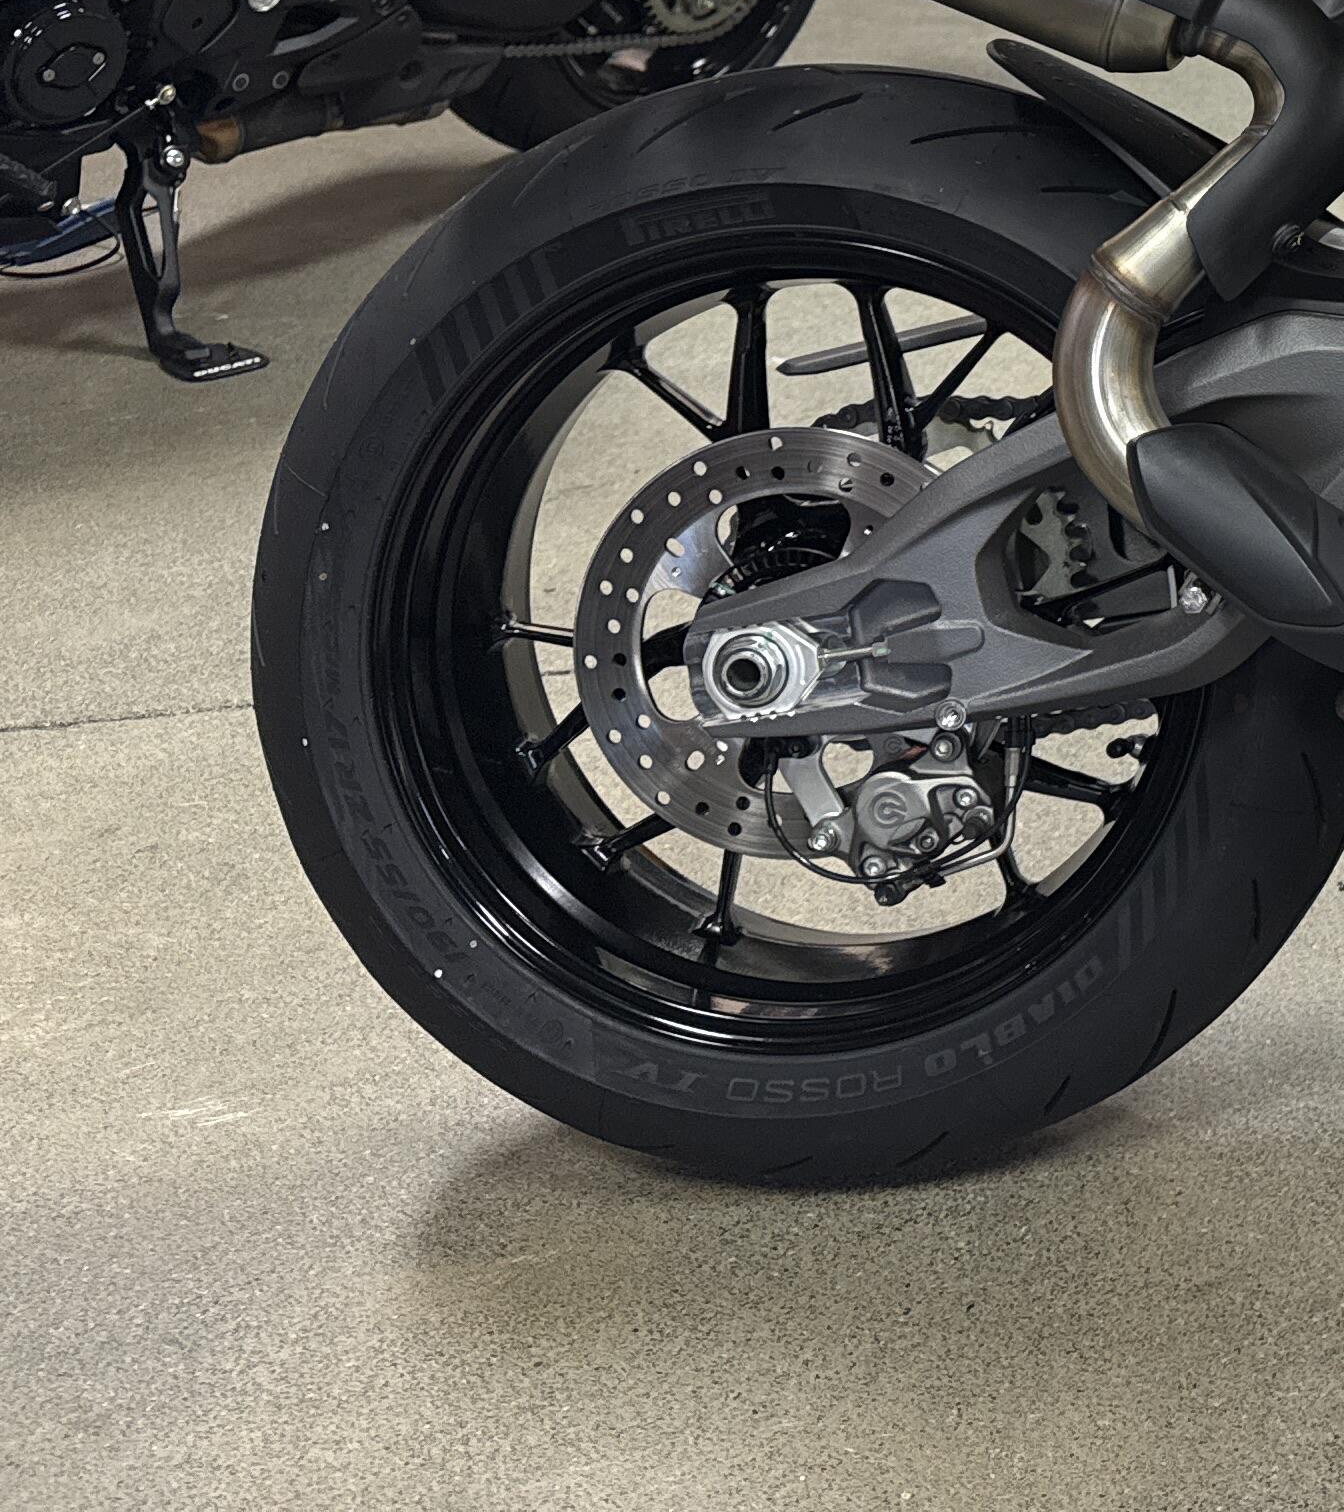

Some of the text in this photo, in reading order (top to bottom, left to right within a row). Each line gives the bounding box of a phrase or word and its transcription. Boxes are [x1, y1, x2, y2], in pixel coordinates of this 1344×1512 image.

[619, 189, 777, 246] PIRELLI
[924, 954, 1103, 1076] DIABLO
[726, 1065, 902, 1103] ROSSO
